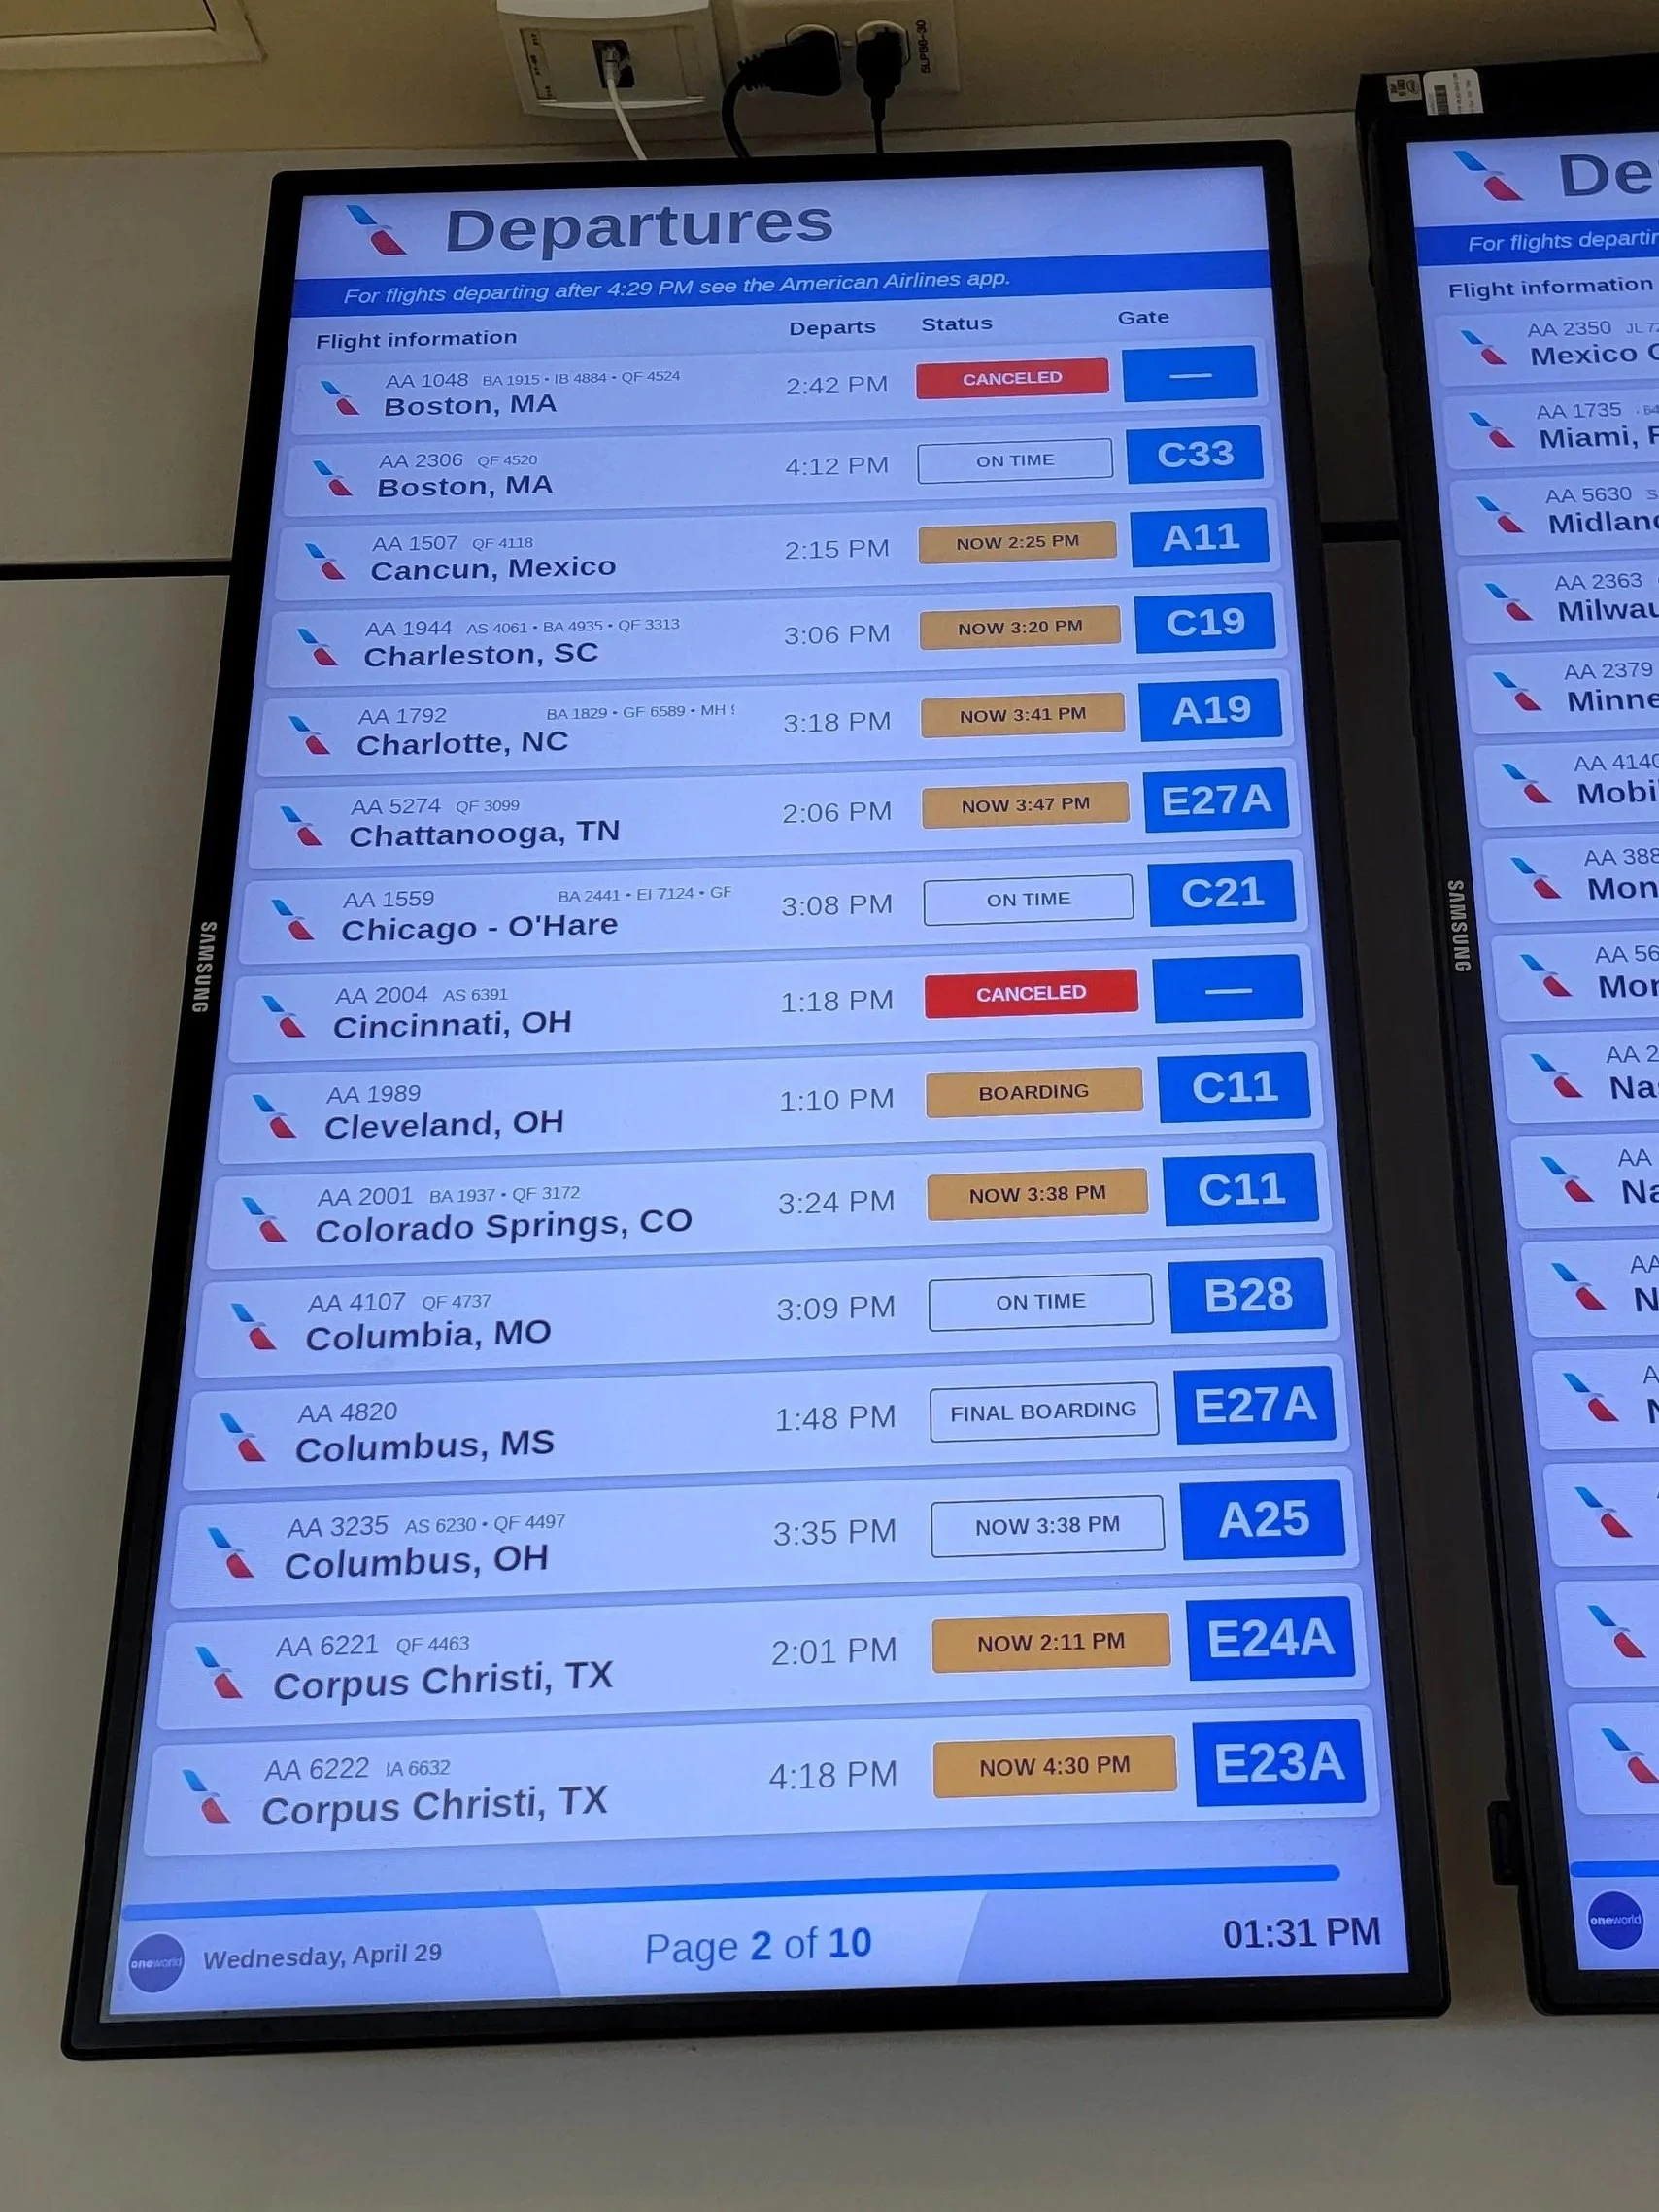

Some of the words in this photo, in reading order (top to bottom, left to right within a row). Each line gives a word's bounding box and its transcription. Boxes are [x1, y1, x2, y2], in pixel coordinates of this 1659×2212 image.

[446, 203, 834, 261] Departures
[1469, 237, 1505, 252] For
[1510, 233, 1573, 253] flights
[342, 288, 381, 305] For
[385, 287, 447, 307] flights
[452, 284, 549, 304] departing
[555, 283, 602, 298] after
[607, 281, 653, 296] 4:29
[659, 280, 694, 295] PM
[699, 281, 737, 294] see
[744, 277, 775, 292] the
[779, 275, 878, 291] American
[883, 272, 961, 289] Airlines
[967, 273, 1009, 289] app.
[1449, 282, 1515, 301] Flight
[1521, 277, 1653, 295] information
[790, 321, 876, 339] Departs
[922, 318, 993, 331] Status
[1118, 311, 1169, 324] Gate
[1528, 323, 1558, 338] AA
[1563, 320, 1611, 337] 2350
[1626, 323, 1643, 334] JL
[317, 333, 381, 353] Flight
[389, 330, 517, 347] information
[1531, 344, 1638, 366] Mexico
[385, 374, 415, 389] AA
[421, 372, 468, 388] 1048
[483, 375, 503, 386] BA
[507, 375, 540, 386] 1915
[555, 374, 570, 384] IB
[573, 372, 607, 384] 4884
[622, 371, 643, 385] QF
[647, 370, 680, 381] 4524
[964, 371, 1063, 386] CANCELED
[385, 397, 499, 417] Boston,
[511, 394, 557, 413] MA
[1537, 404, 1567, 420] AA
[1573, 401, 1621, 418] 1735
[1540, 425, 1638, 449] Miami,
[977, 456, 1003, 467] ON
[1009, 454, 1055, 466] TIME
[1158, 440, 1234, 467] C33
[378, 478, 494, 498] Boston,
[506, 475, 553, 494] MA
[1545, 489, 1576, 504] AA
[1581, 486, 1632, 502] 5630
[372, 536, 403, 552] AA
[409, 534, 457, 551] 1507
[473, 538, 493, 552] QF
[498, 536, 534, 548] 4118
[957, 537, 1002, 551] NOW
[1008, 535, 1046, 549] 2:25
[1052, 534, 1079, 547] PM
[1163, 523, 1240, 552] A11
[371, 562, 497, 582] Cancun,
[509, 556, 616, 578] Mexico
[1555, 575, 1587, 591] AA
[1592, 572, 1642, 590] 2363
[1168, 608, 1245, 636] C19
[364, 644, 543, 667] Charleston,
[555, 642, 598, 663] SC
[357, 709, 390, 725] AA
[396, 707, 447, 724] 1792
[547, 709, 568, 720] BA
[572, 707, 607, 719] 1829
[624, 706, 645, 718] GF
[650, 704, 685, 717] 6589
[701, 703, 726, 716] MH
[1172, 695, 1251, 725] A19
[357, 732, 510, 757] Charlotte,
[523, 732, 568, 752] NC
[1163, 784, 1272, 816] E27A
[350, 825, 564, 849] Chattanooga,
[576, 820, 619, 841] TN
[1182, 876, 1265, 908] C21
[342, 917, 477, 945] Chicago
[509, 914, 618, 936] O'Hare
[1447, 879, 1473, 972] SAMSUNG
[192, 921, 218, 1013] SAMSUNG
[334, 987, 368, 1004] AA
[374, 986, 428, 1004] 2004
[443, 989, 466, 1002] AS
[471, 988, 508, 1001] 6391
[977, 985, 1087, 1002] CANCELED
[334, 1010, 509, 1038] Cincinnati,
[522, 1010, 571, 1034] OH
[980, 1084, 1089, 1101] BOARDING
[1193, 1071, 1278, 1104] C11
[325, 1110, 500, 1140] Cleveland,
[514, 1109, 563, 1134] OH
[317, 1188, 352, 1207] AA
[358, 1186, 413, 1206] 2001
[430, 1190, 454, 1204] BA
[457, 1188, 495, 1203] 1937
[513, 1187, 536, 1204] QF
[542, 1186, 580, 1200] 3172
[1199, 1172, 1286, 1206] C11
[316, 1214, 474, 1243] Colorado
[486, 1210, 627, 1243] Springs,
[640, 1208, 692, 1233] CO
[1205, 1277, 1293, 1312] B28
[777, 1297, 838, 1321] 3:09
[851, 1295, 895, 1318] PM
[306, 1320, 481, 1351] Columbia,
[494, 1319, 551, 1344] MO
[951, 1405, 1014, 1422] FINAL
[1021, 1401, 1136, 1419] BOARDING
[1196, 1386, 1317, 1423] E27A
[296, 1432, 488, 1463] Columbus,
[501, 1430, 554, 1456] MS
[287, 1517, 322, 1539] AA
[330, 1515, 389, 1537] 3235
[404, 1519, 429, 1534] AS
[436, 1517, 476, 1533] 6230
[494, 1515, 521, 1534] QF
[525, 1514, 565, 1529] 4497
[1219, 1500, 1309, 1538] A25
[286, 1547, 480, 1580] Columbus,
[494, 1544, 548, 1572] OH
[978, 1635, 1033, 1652] NOW
[1040, 1633, 1085, 1650] 2:11
[1093, 1632, 1125, 1650] PM
[1208, 1617, 1336, 1658] E24A
[274, 1673, 409, 1706] Corpus
[423, 1661, 552, 1696] Christi,
[564, 1660, 613, 1689] TX
[264, 1759, 302, 1782] AA
[310, 1756, 369, 1780] 6222
[408, 1759, 451, 1776] 6632
[1216, 1741, 1345, 1783] E23A
[262, 1797, 399, 1832] Corpus
[413, 1786, 545, 1821] Christi,
[559, 1785, 608, 1815] TX
[1590, 1914, 1642, 1925] oneworld
[1224, 1919, 1317, 1949] 01:31
[1327, 1917, 1380, 1946] PM
[204, 1947, 346, 1970] Wednesday,
[352, 1943, 408, 1969] April
[414, 1943, 442, 1961] 29
[647, 1934, 738, 1971] Page
[751, 1930, 771, 1960] 2
[785, 1926, 818, 1959] of
[830, 1927, 871, 1957] 10
[131, 1956, 183, 1969] oneworld
